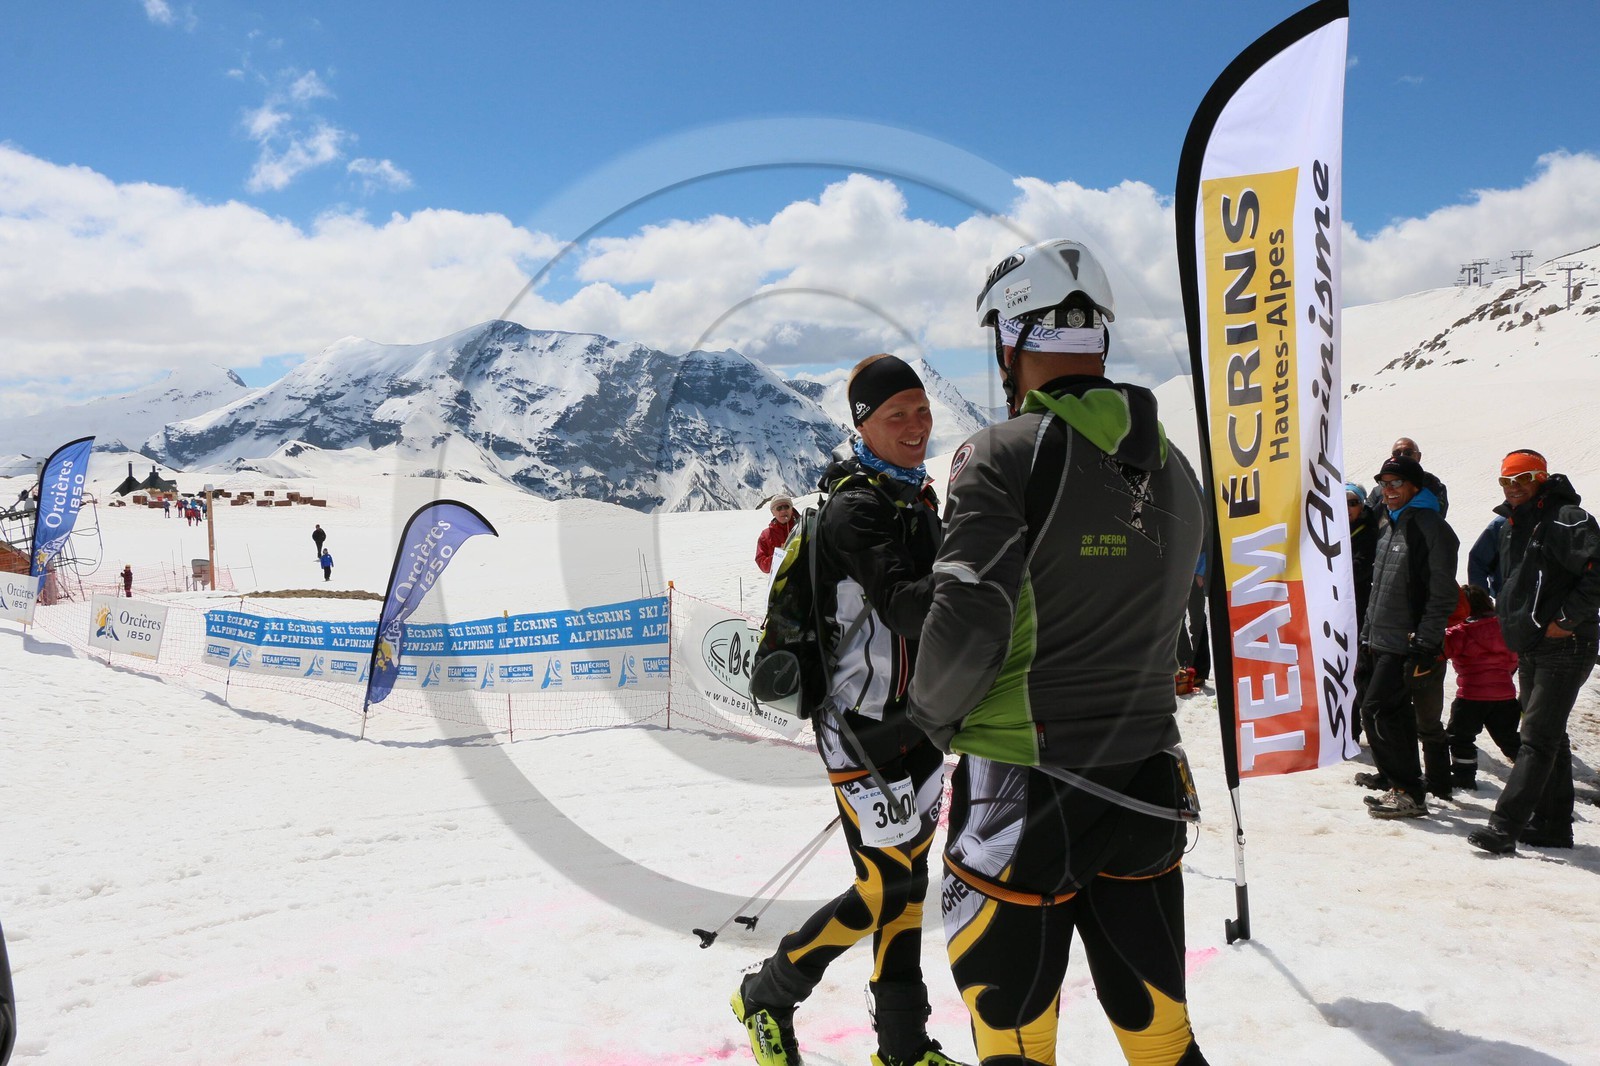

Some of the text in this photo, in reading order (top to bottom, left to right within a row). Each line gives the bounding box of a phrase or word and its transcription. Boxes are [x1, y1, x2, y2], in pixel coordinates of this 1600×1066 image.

[1264, 228, 1292, 463] Hautes-Alpes
[1221, 188, 1305, 772] TEAM ÉCRINS
[45, 460, 74, 529] Orcières
[69, 474, 85, 514] 1850
[1100, 534, 1127, 545] PIERRA
[1080, 546, 1127, 556] MENTA 2011
[395, 520, 451, 604] Orcières
[420, 545, 453, 591] 1850
[7, 583, 35, 600] Orcières
[11, 600, 28, 610] 1850
[209, 612, 224, 622] SKI
[638, 605, 659, 619] SKI
[119, 610, 162, 631] Orcières
[263, 622, 284, 631] SKI
[565, 616, 586, 627] SKI
[127, 630, 151, 642] 1850
[329, 626, 347, 635] SKI
[447, 627, 464, 637] SKI
[569, 627, 633, 643] ALPINISME
[262, 633, 325, 646] ALPINISME
[451, 639, 494, 651] ALPINISME
[571, 662, 589, 674] TEAM
